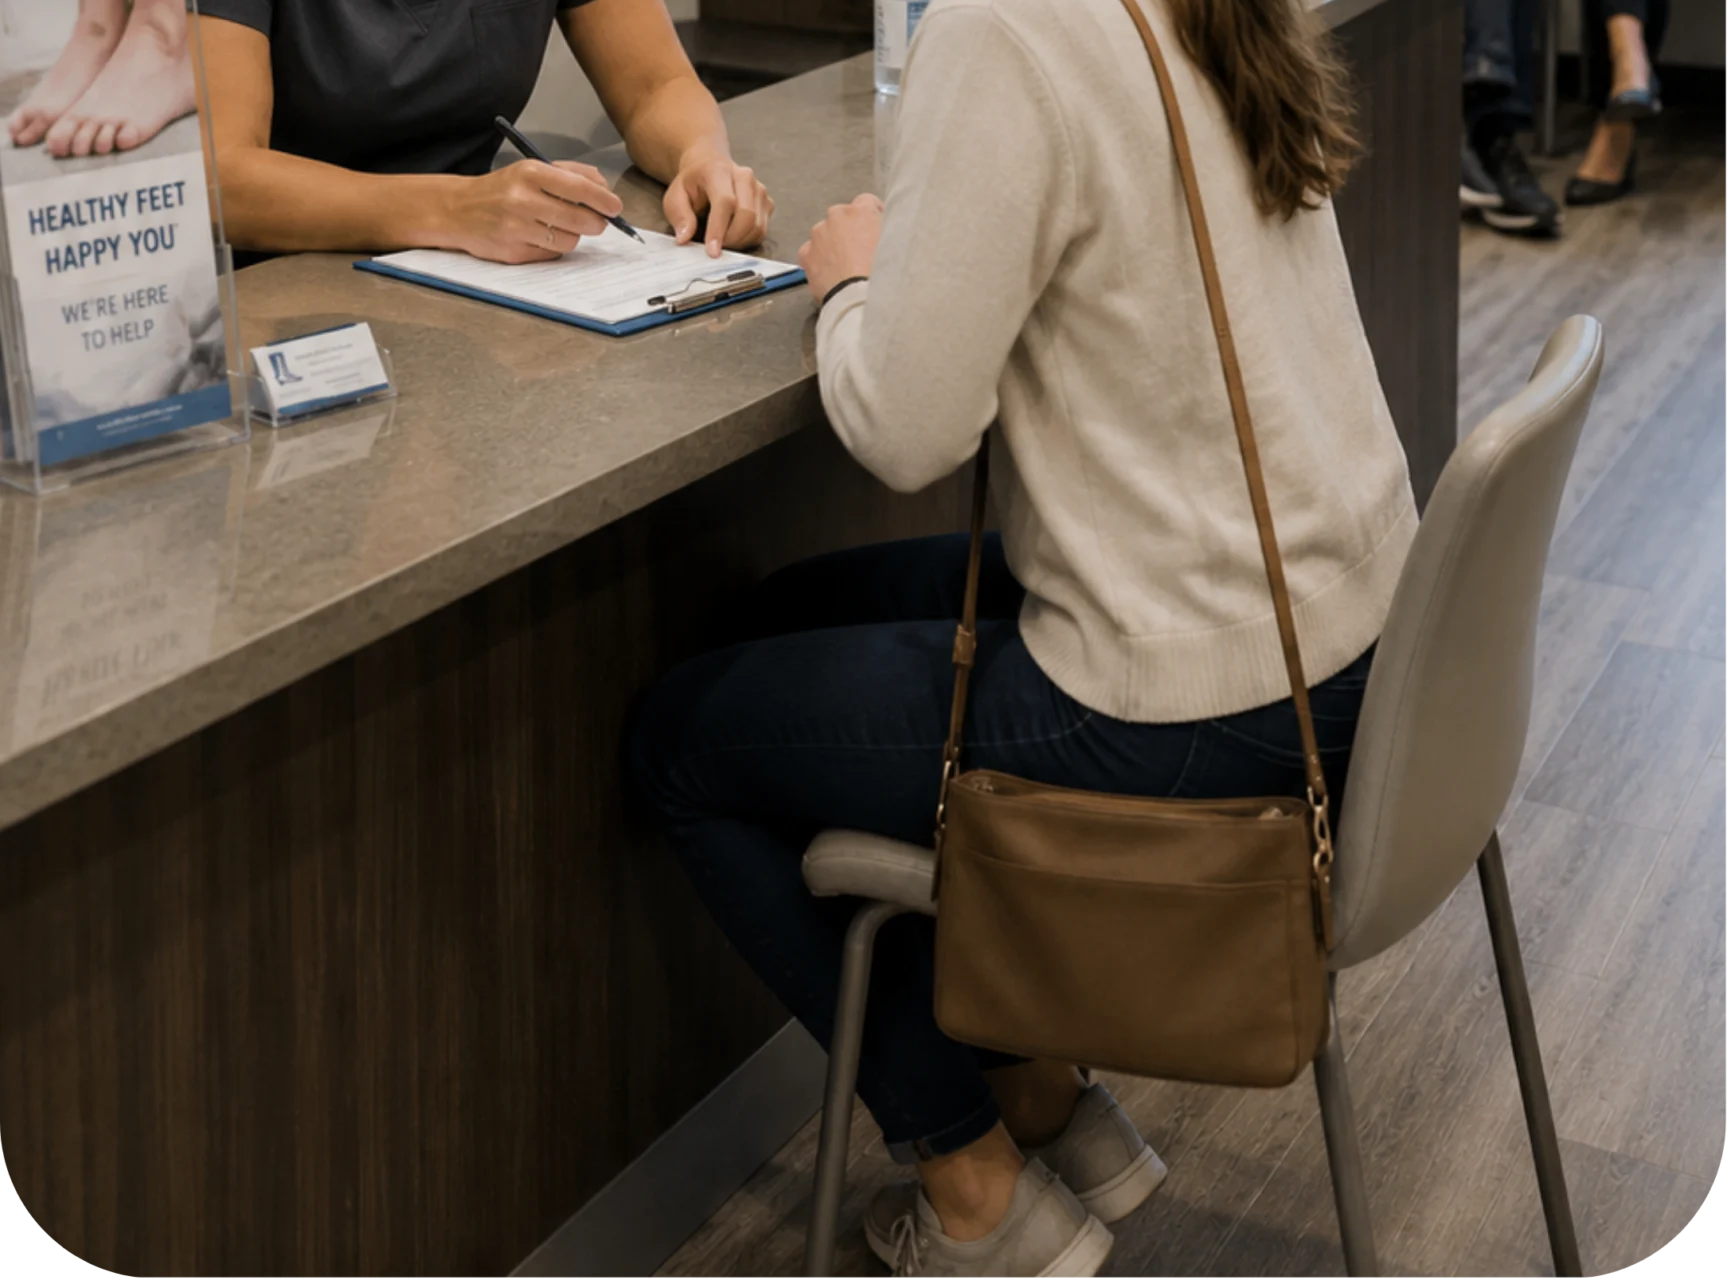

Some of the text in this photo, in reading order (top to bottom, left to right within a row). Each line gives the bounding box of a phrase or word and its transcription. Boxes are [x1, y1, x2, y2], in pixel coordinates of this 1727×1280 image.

[28, 180, 185, 235] HEALTHY FEET
[45, 223, 175, 274] HAPPY YOU
[123, 283, 169, 312] HERE
[81, 317, 154, 352] TO HELP
